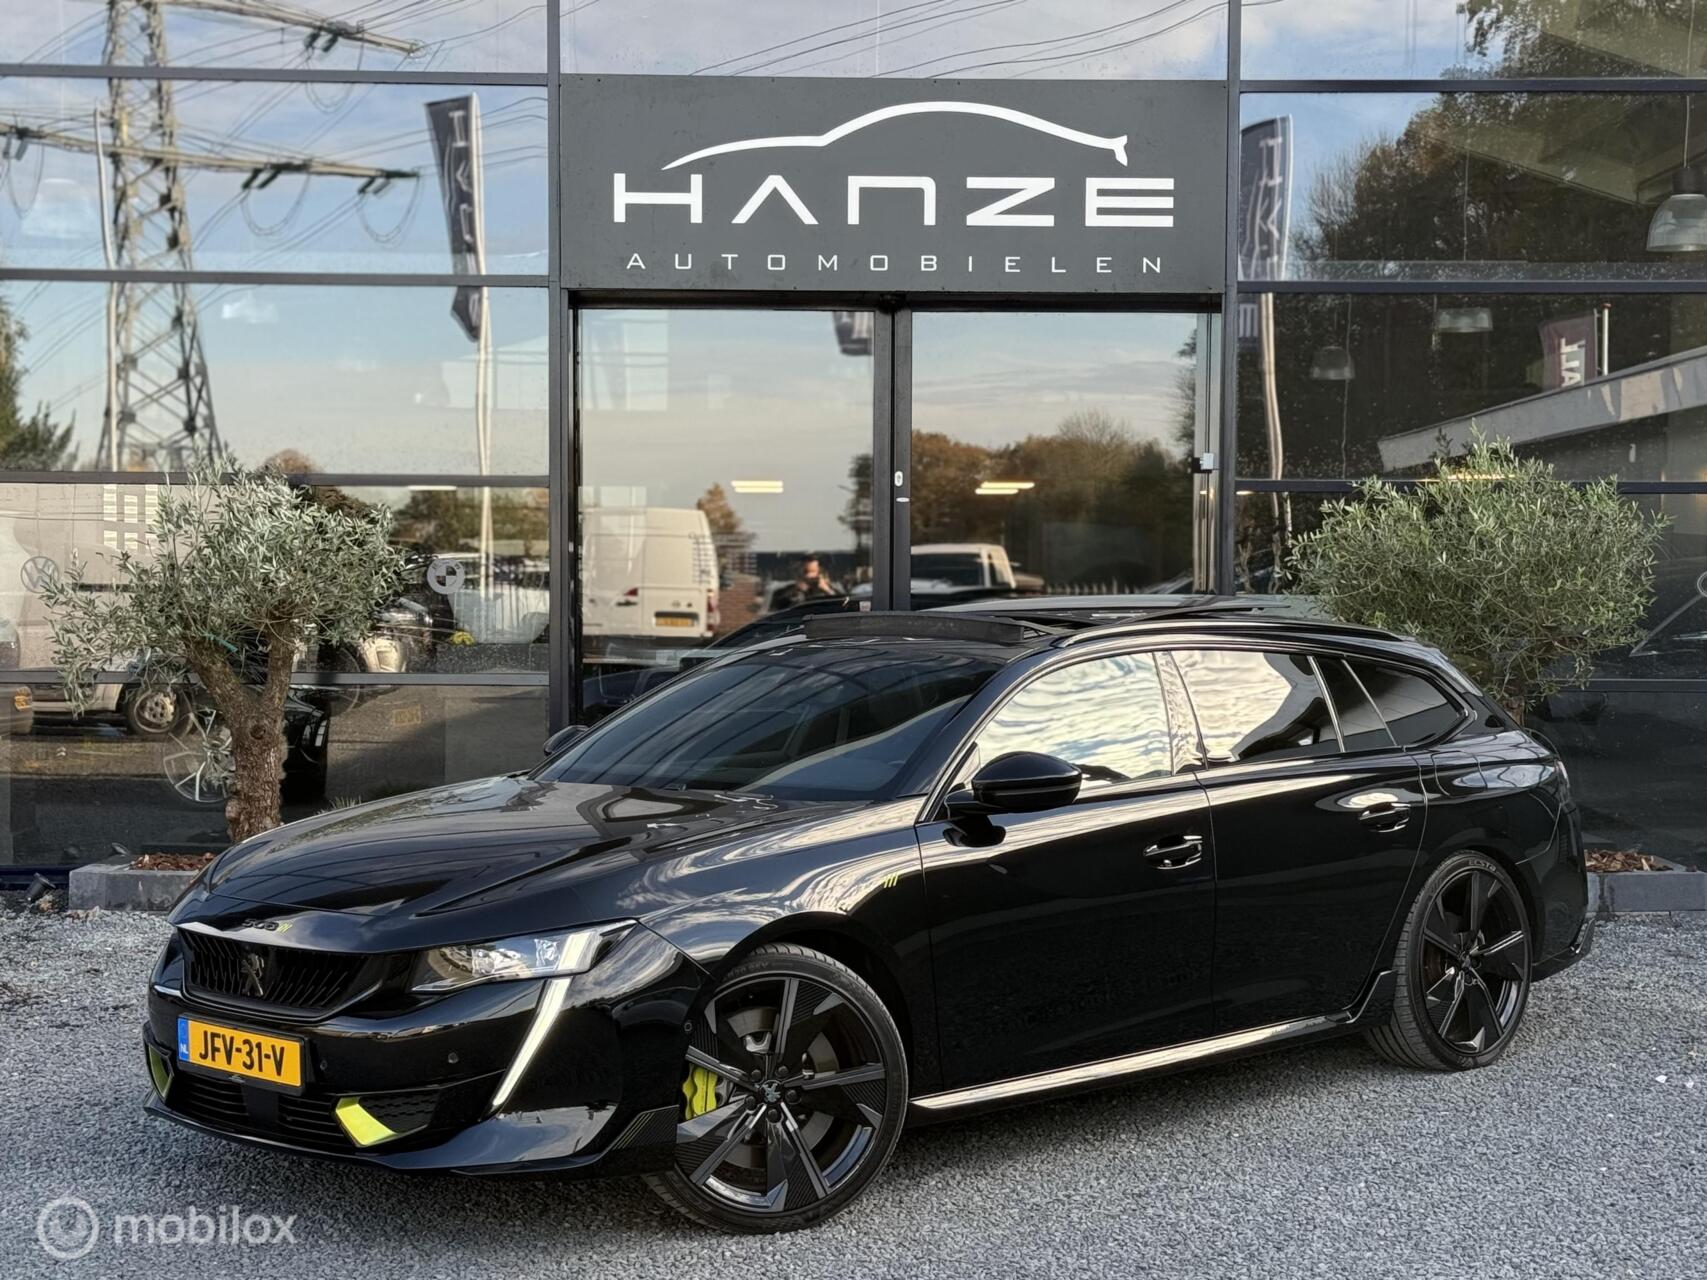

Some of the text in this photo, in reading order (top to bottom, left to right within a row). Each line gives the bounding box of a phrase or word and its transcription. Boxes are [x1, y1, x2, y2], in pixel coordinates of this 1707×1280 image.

[614, 173, 1174, 227] HANZE
[627, 253, 1160, 273] AUTOMOBIELEN
[199, 1030, 285, 1077] JFV-31-V
